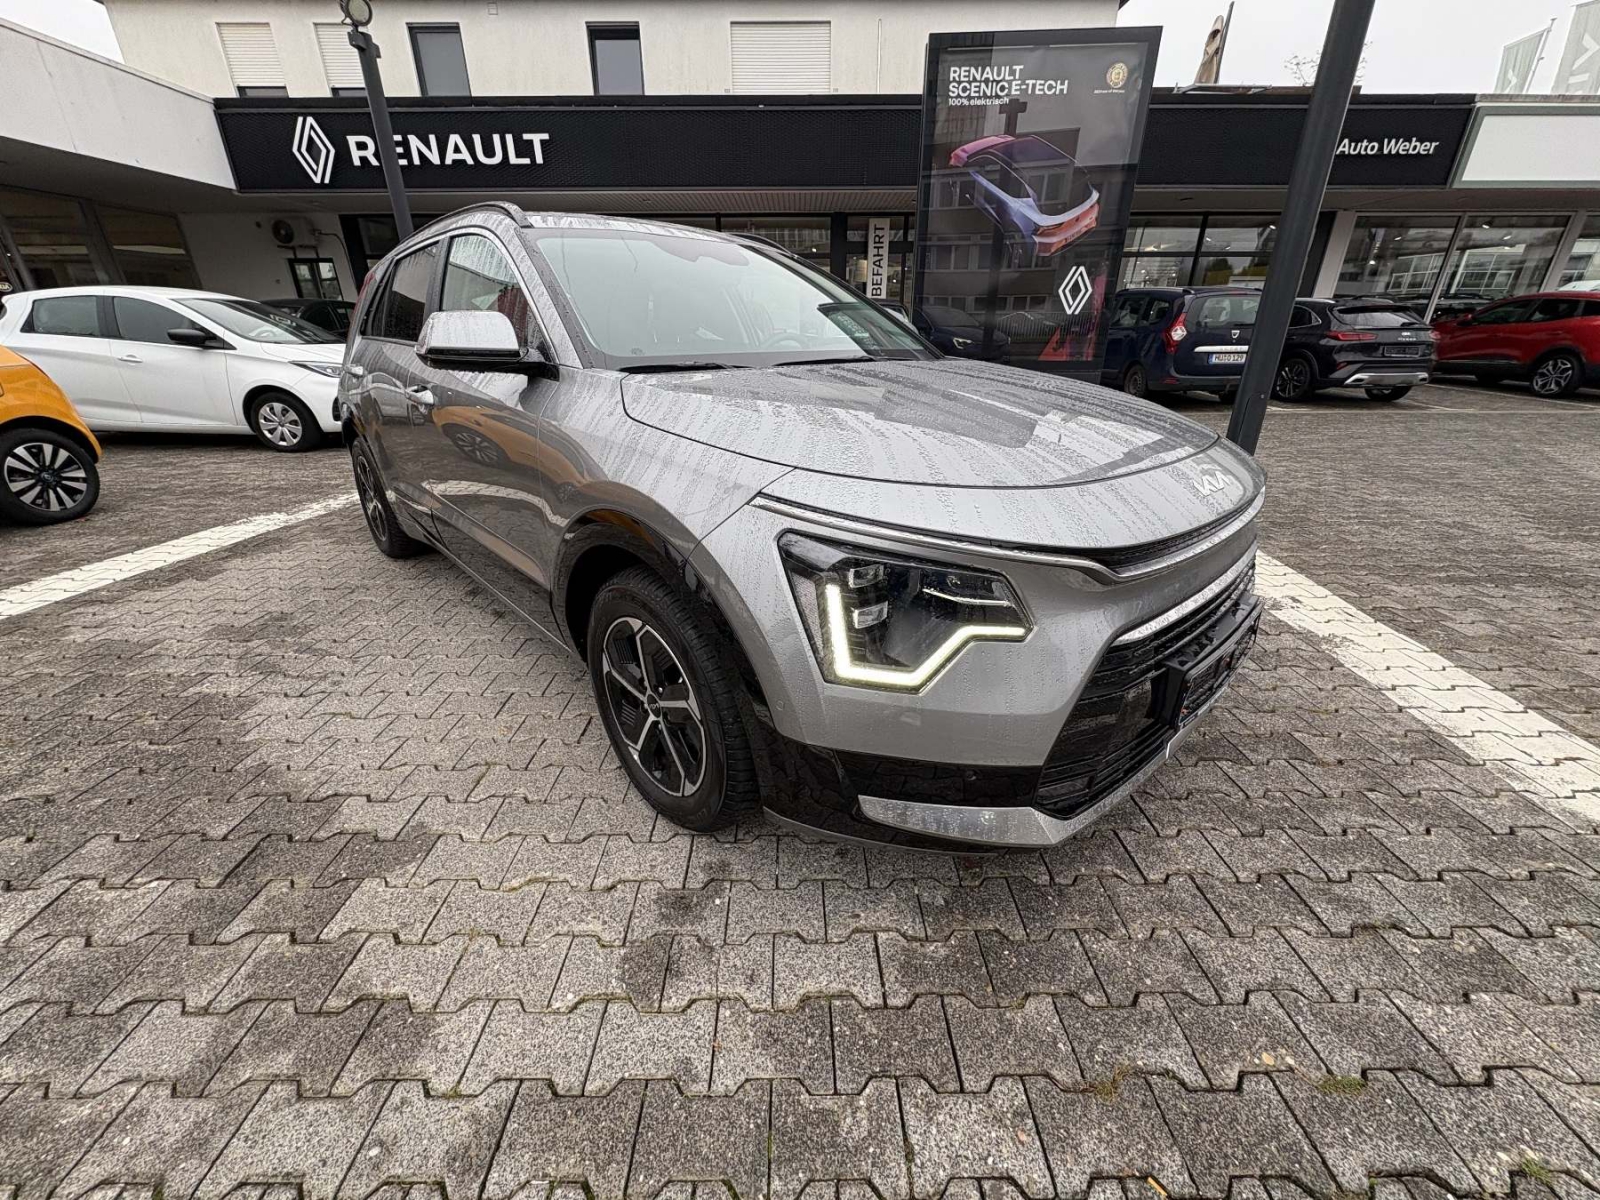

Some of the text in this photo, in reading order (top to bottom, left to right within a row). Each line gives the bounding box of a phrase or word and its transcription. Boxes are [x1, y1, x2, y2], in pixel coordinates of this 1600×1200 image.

[949, 65, 1024, 81] RENAULT
[948, 79, 1069, 97] SCENIC E-TECH
[948, 97, 1009, 106] 100% elektrisch
[1336, 137, 1440, 155] Auto Weber
[871, 224, 885, 297] BEFAHRT
